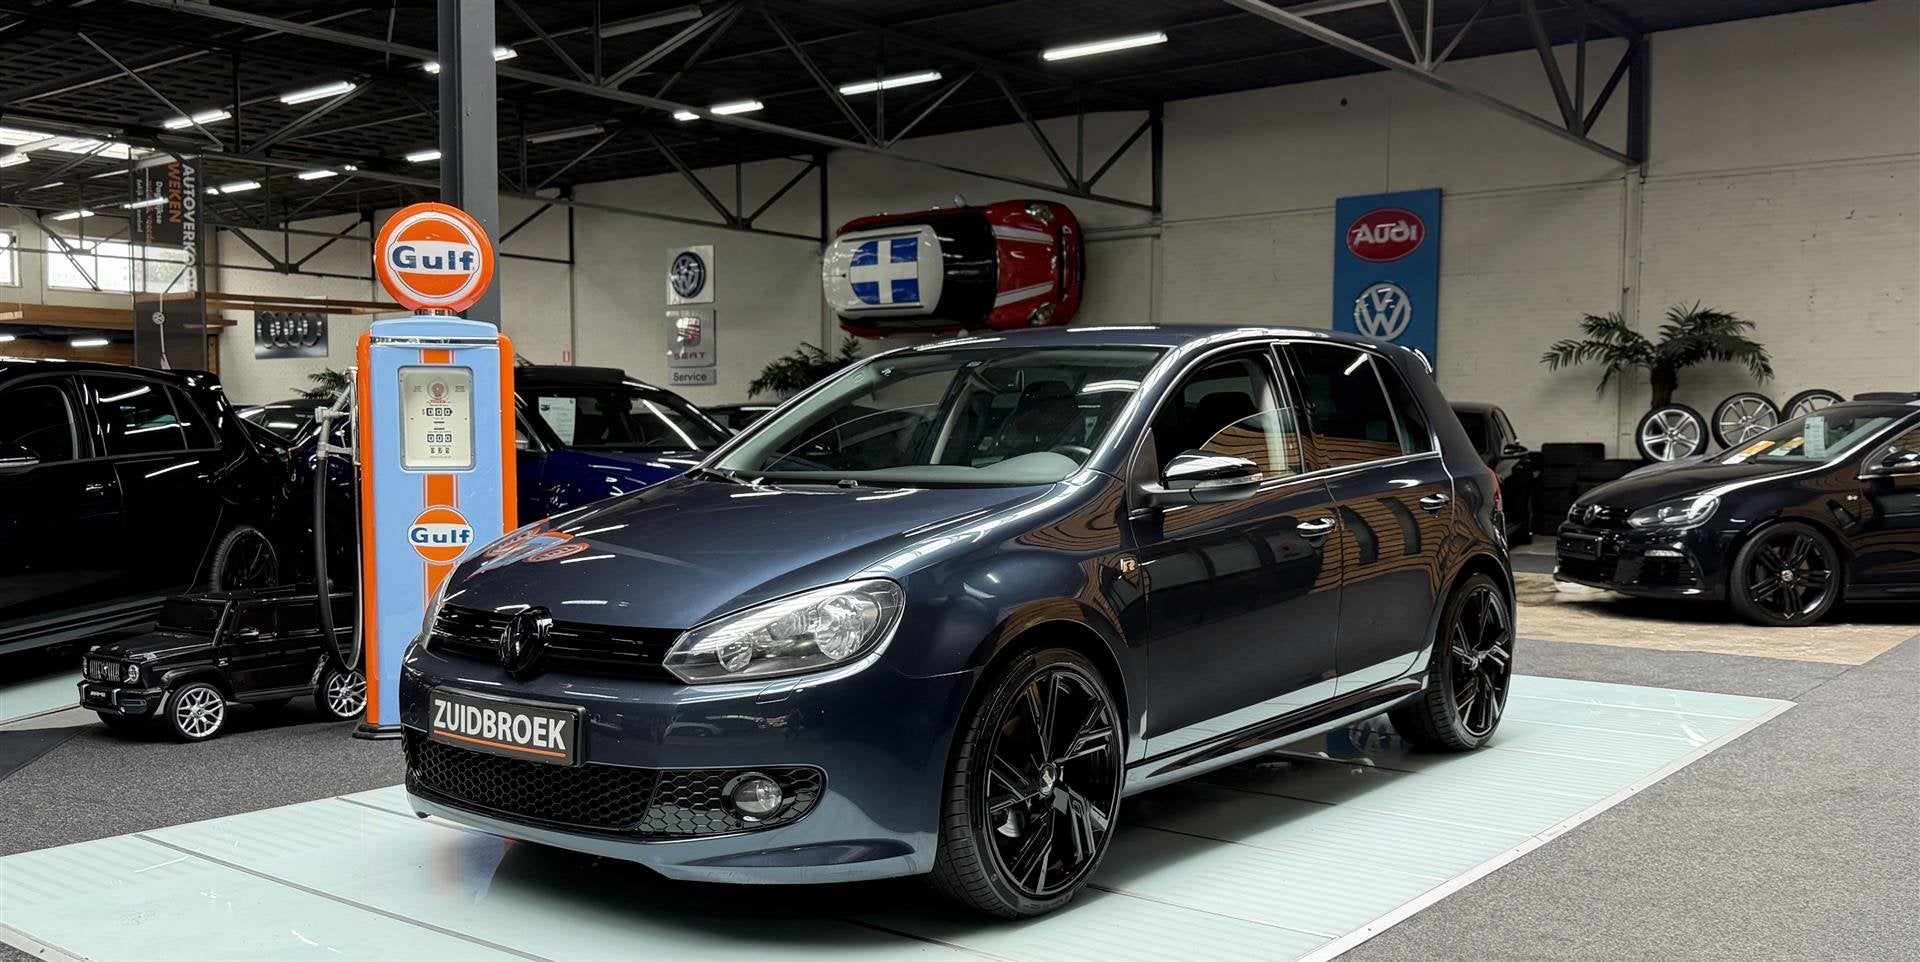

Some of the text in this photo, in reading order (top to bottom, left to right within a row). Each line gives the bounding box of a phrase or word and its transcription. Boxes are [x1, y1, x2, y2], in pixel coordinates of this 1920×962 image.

[168, 163, 182, 225] WEKEN
[392, 245, 475, 271] Gulf
[673, 372, 707, 381] Service
[411, 527, 471, 544] Gulf
[433, 699, 566, 750] ZUIDBROEK
